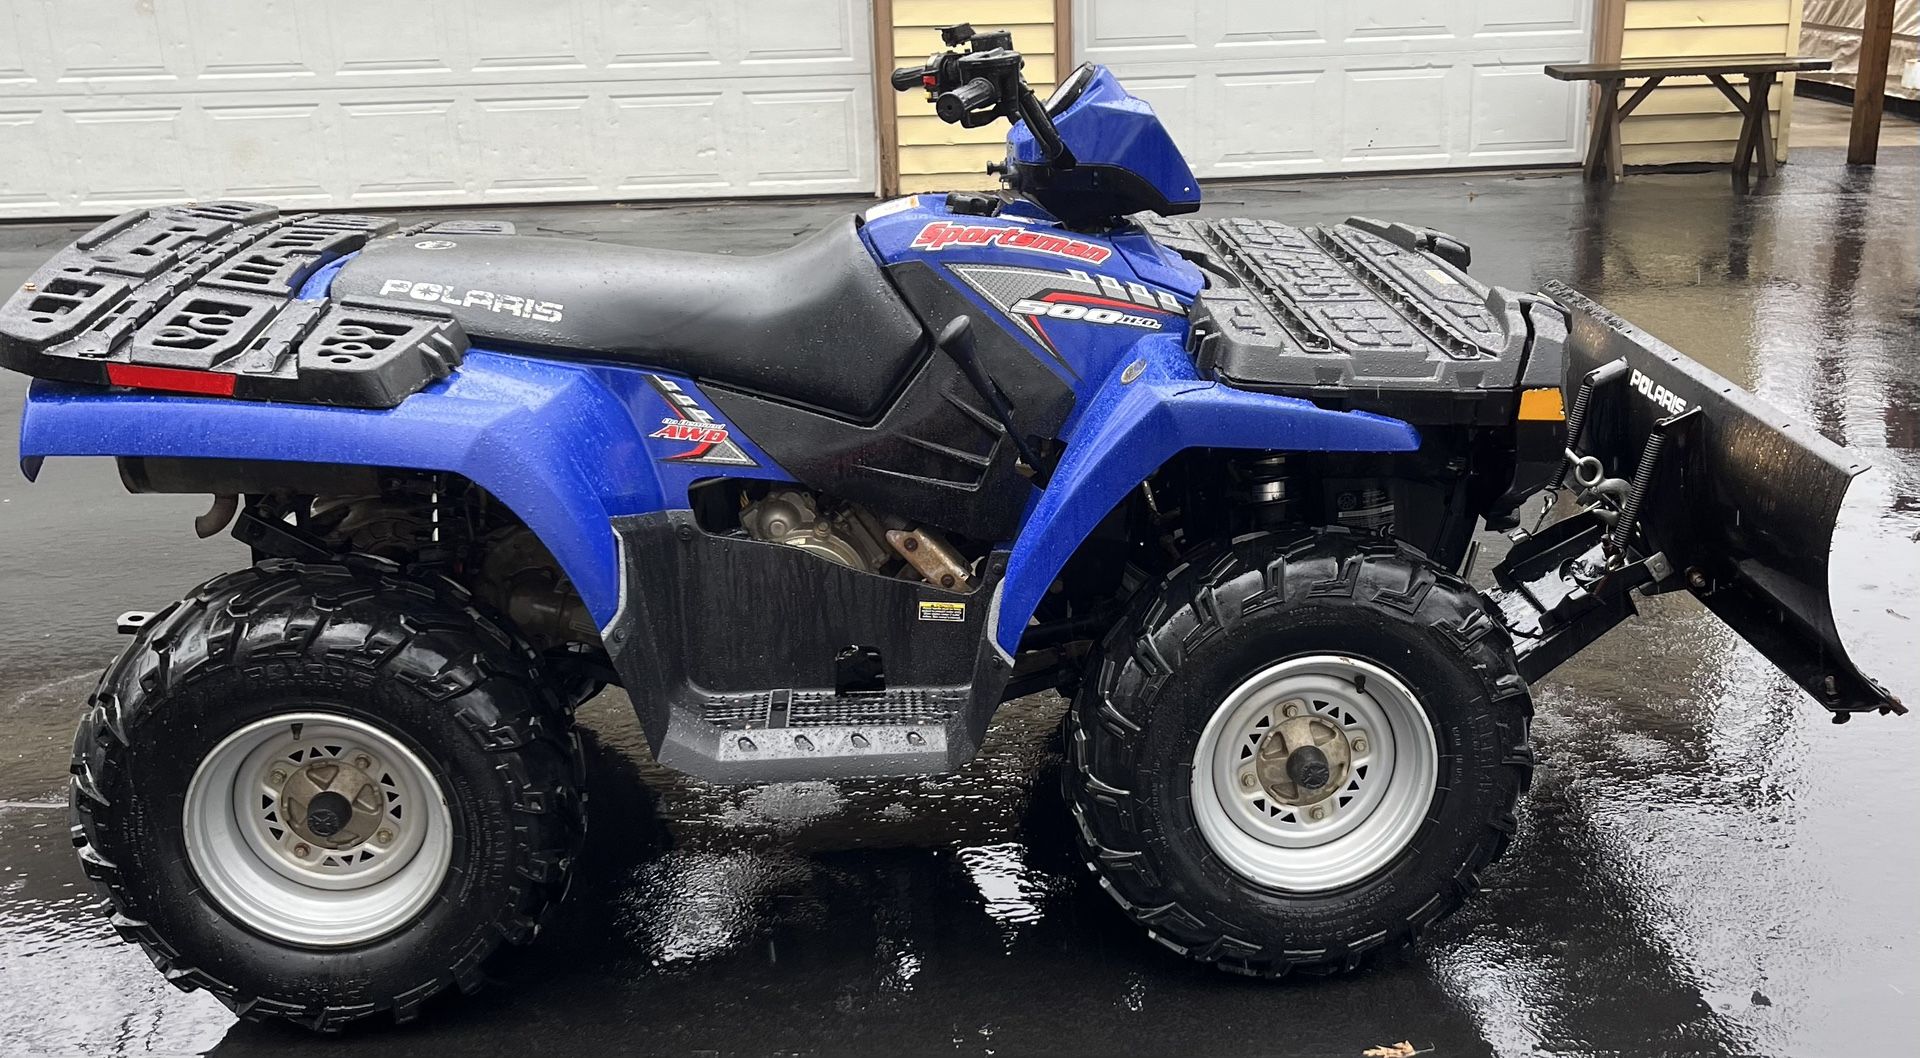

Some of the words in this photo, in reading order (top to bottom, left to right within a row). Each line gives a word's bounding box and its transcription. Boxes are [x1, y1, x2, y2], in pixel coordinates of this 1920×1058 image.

[910, 221, 1112, 264] Sportsman
[380, 279, 564, 323] POLARIS
[1009, 298, 1124, 324] 500
[1629, 368, 1687, 415] POLARIS
[648, 424, 729, 443] AWD
